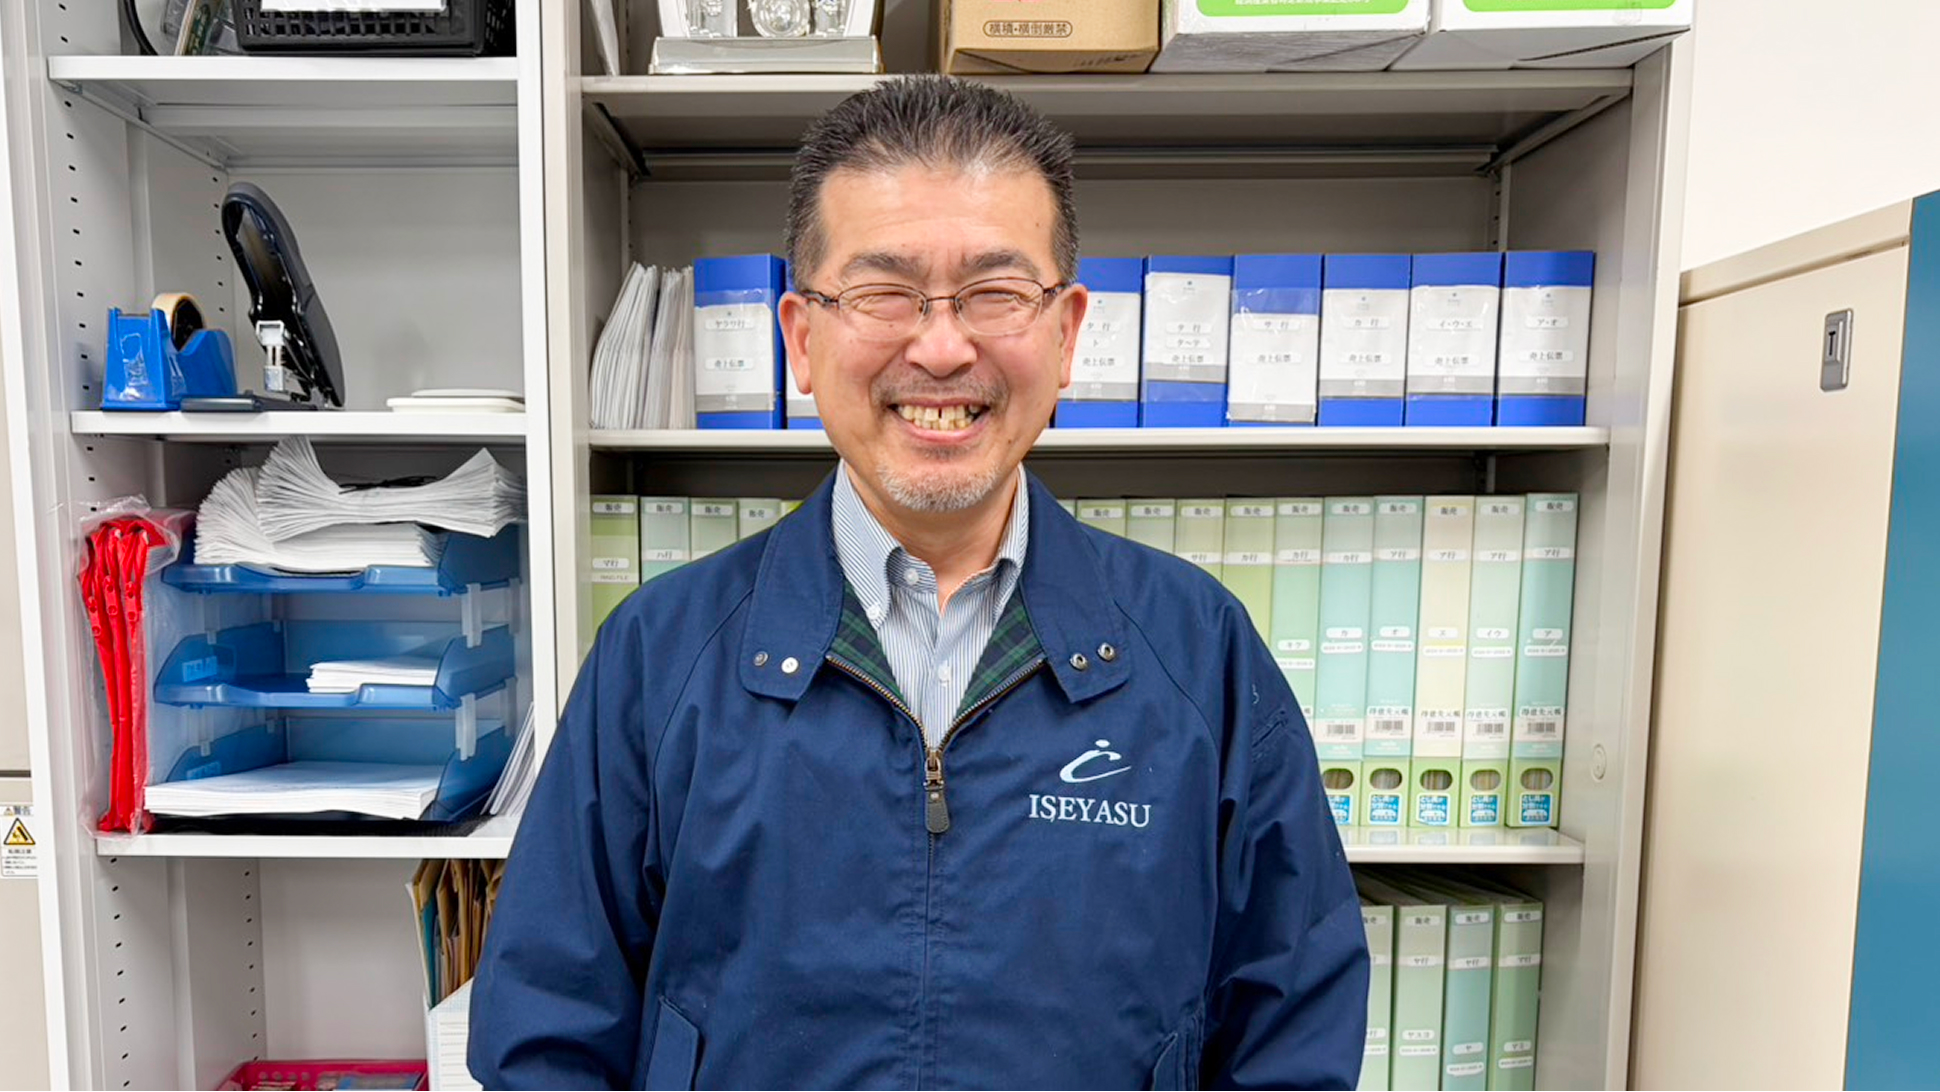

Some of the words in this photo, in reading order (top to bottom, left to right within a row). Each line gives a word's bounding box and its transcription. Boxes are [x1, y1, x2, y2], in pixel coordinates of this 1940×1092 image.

[989, 23, 1067, 35] 横積・横倒厳禁
[605, 503, 623, 512] 販売
[656, 504, 673, 513] 販売
[704, 506, 722, 515] 販売
[1291, 505, 1309, 514] 販売
[1342, 505, 1360, 514] 販売
[1389, 504, 1407, 513] 販売
[1491, 505, 1509, 514] 販売
[1546, 502, 1564, 511] 販売
[748, 510, 766, 519] 販売
[1093, 509, 1111, 518] 販売
[1143, 507, 1162, 516] 販売
[1194, 508, 1212, 517] 販売
[1243, 507, 1262, 516] 販売
[1440, 507, 1458, 516] 販売
[1028, 794, 1152, 828] ISEYASU
